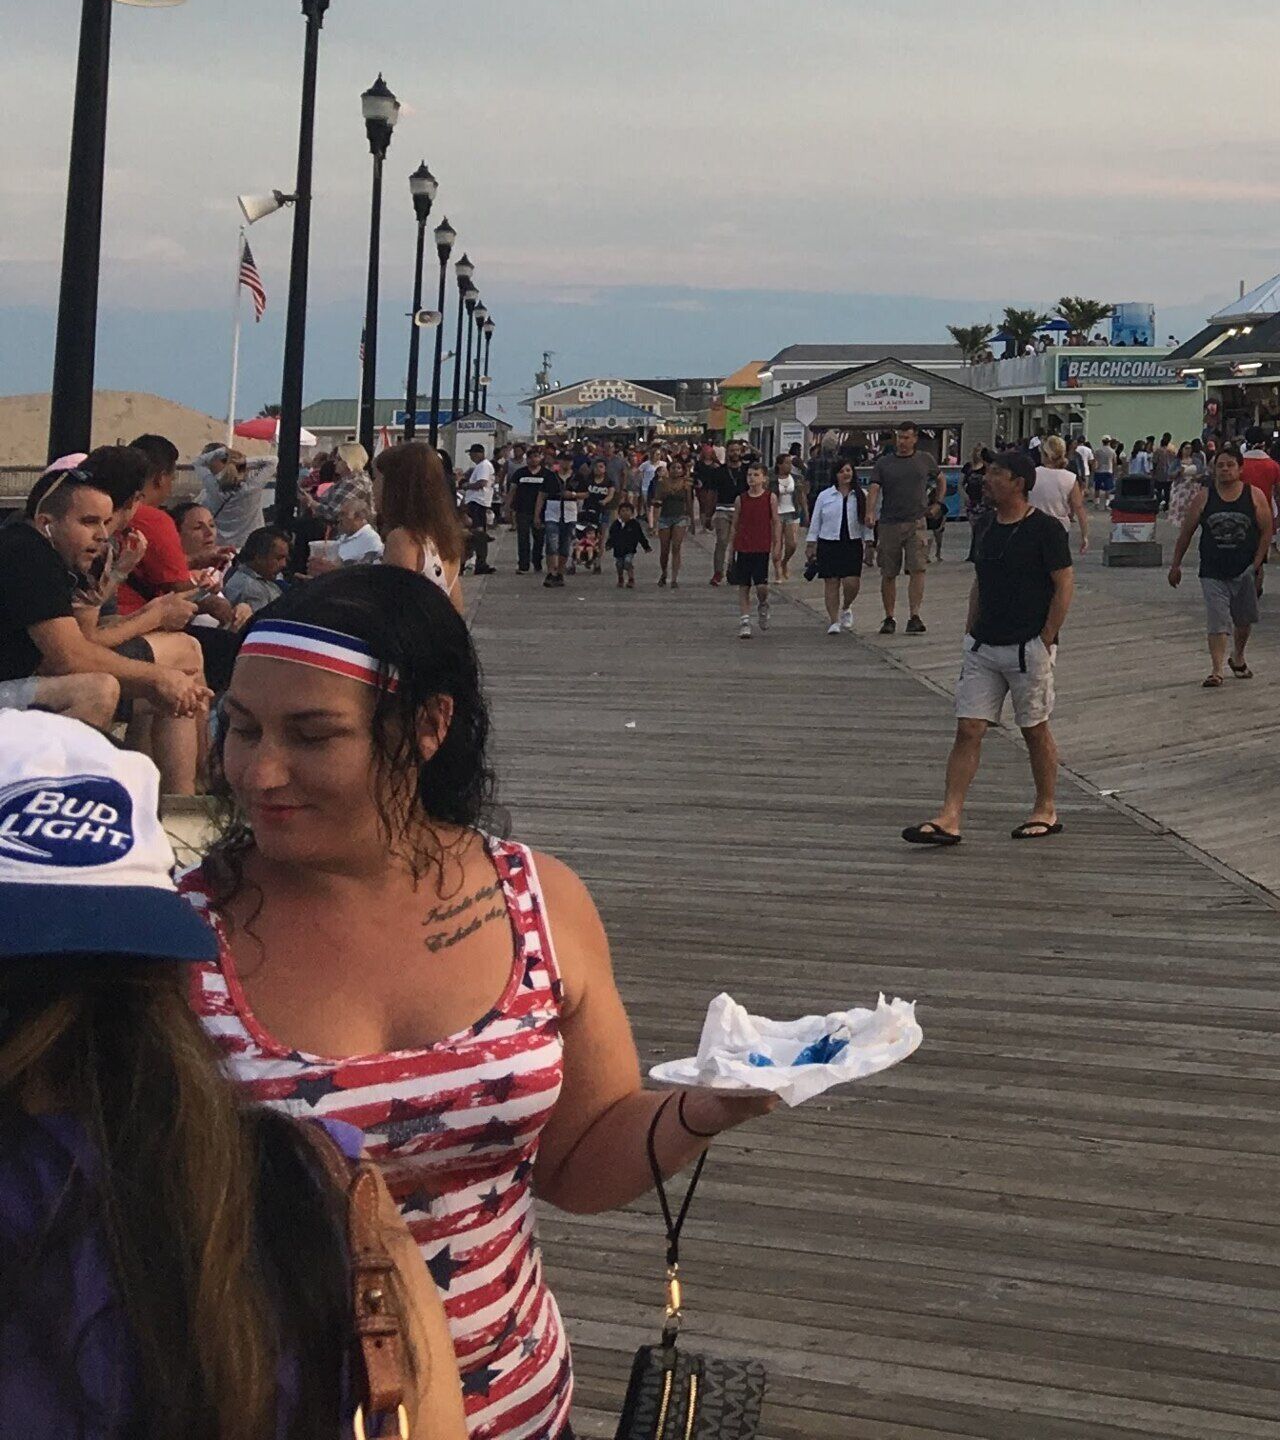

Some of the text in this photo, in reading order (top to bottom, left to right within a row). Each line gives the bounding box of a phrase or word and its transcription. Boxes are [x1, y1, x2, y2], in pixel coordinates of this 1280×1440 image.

[1068, 361, 1177, 378] BEACHCOMBE
[863, 378, 914, 390] SEASIDE
[21, 790, 118, 825] BUD
[0, 813, 132, 846] LIGHT
